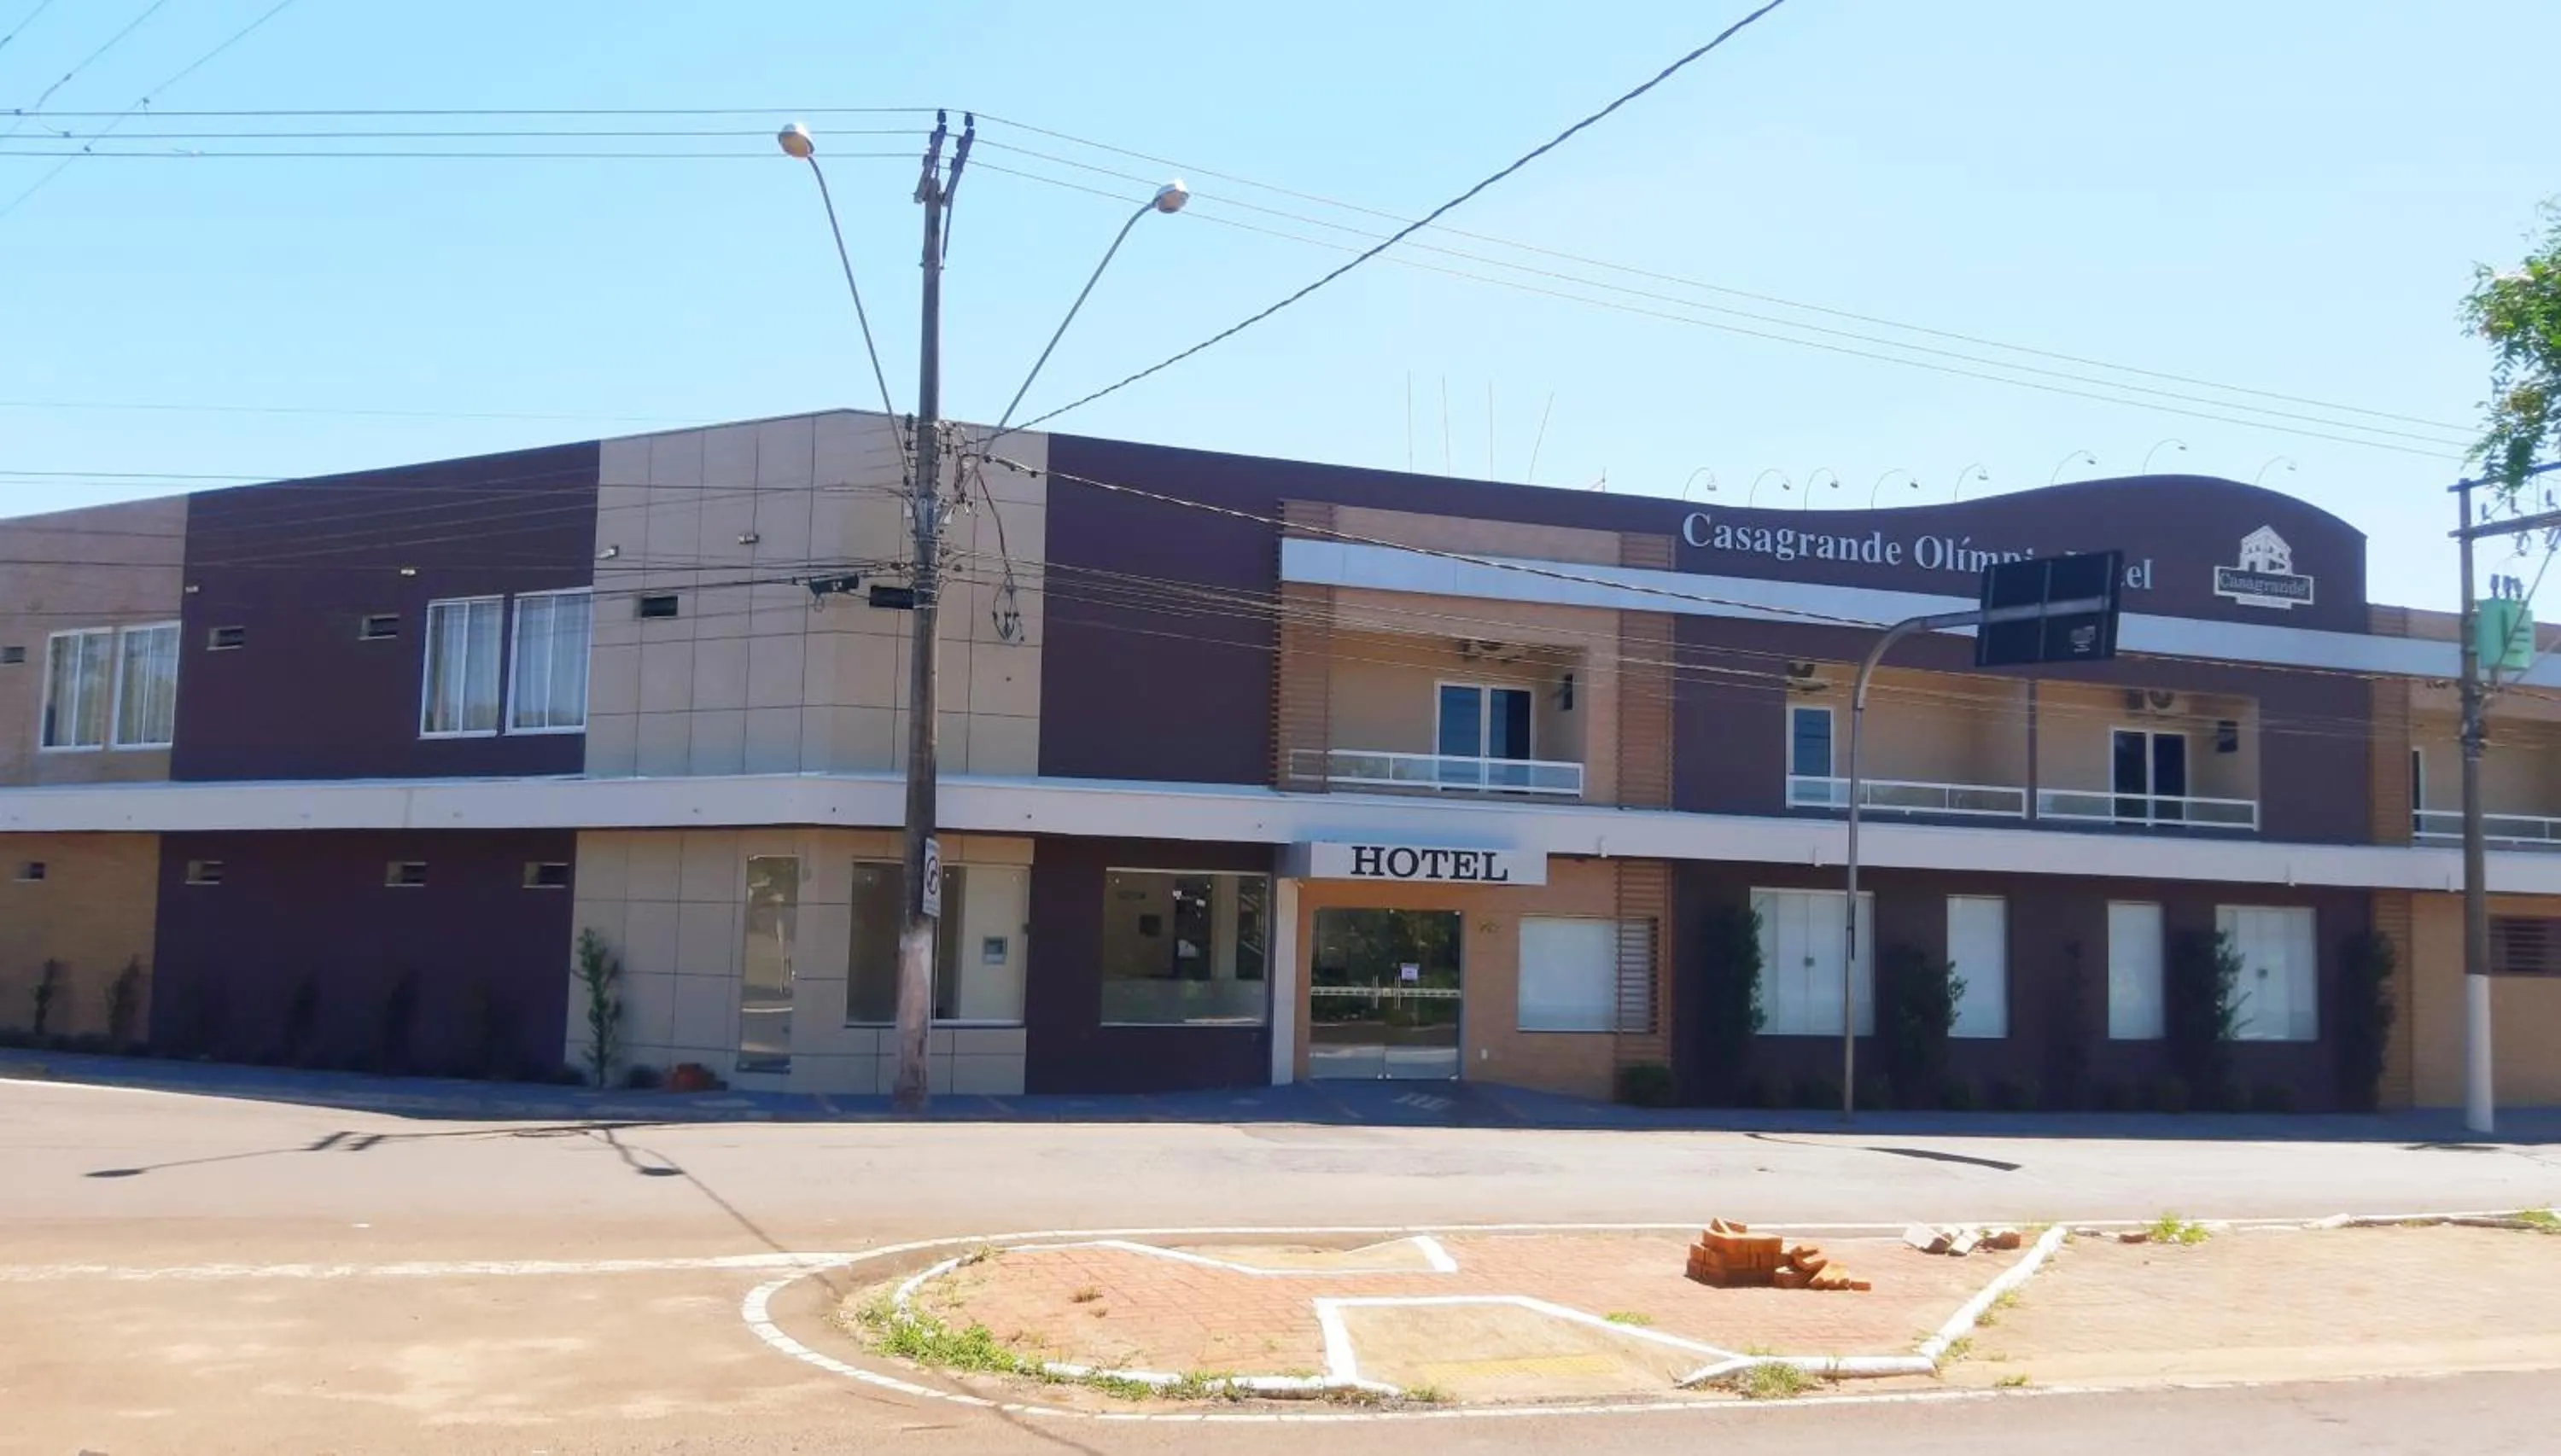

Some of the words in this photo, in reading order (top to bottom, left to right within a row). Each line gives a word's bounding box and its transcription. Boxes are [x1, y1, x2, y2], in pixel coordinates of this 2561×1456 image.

[1683, 512, 1902, 566] Casagrande
[1914, 535, 2034, 574] Olím
[2220, 573, 2307, 596] Casagrande
[1350, 846, 1508, 882] HOTEL
